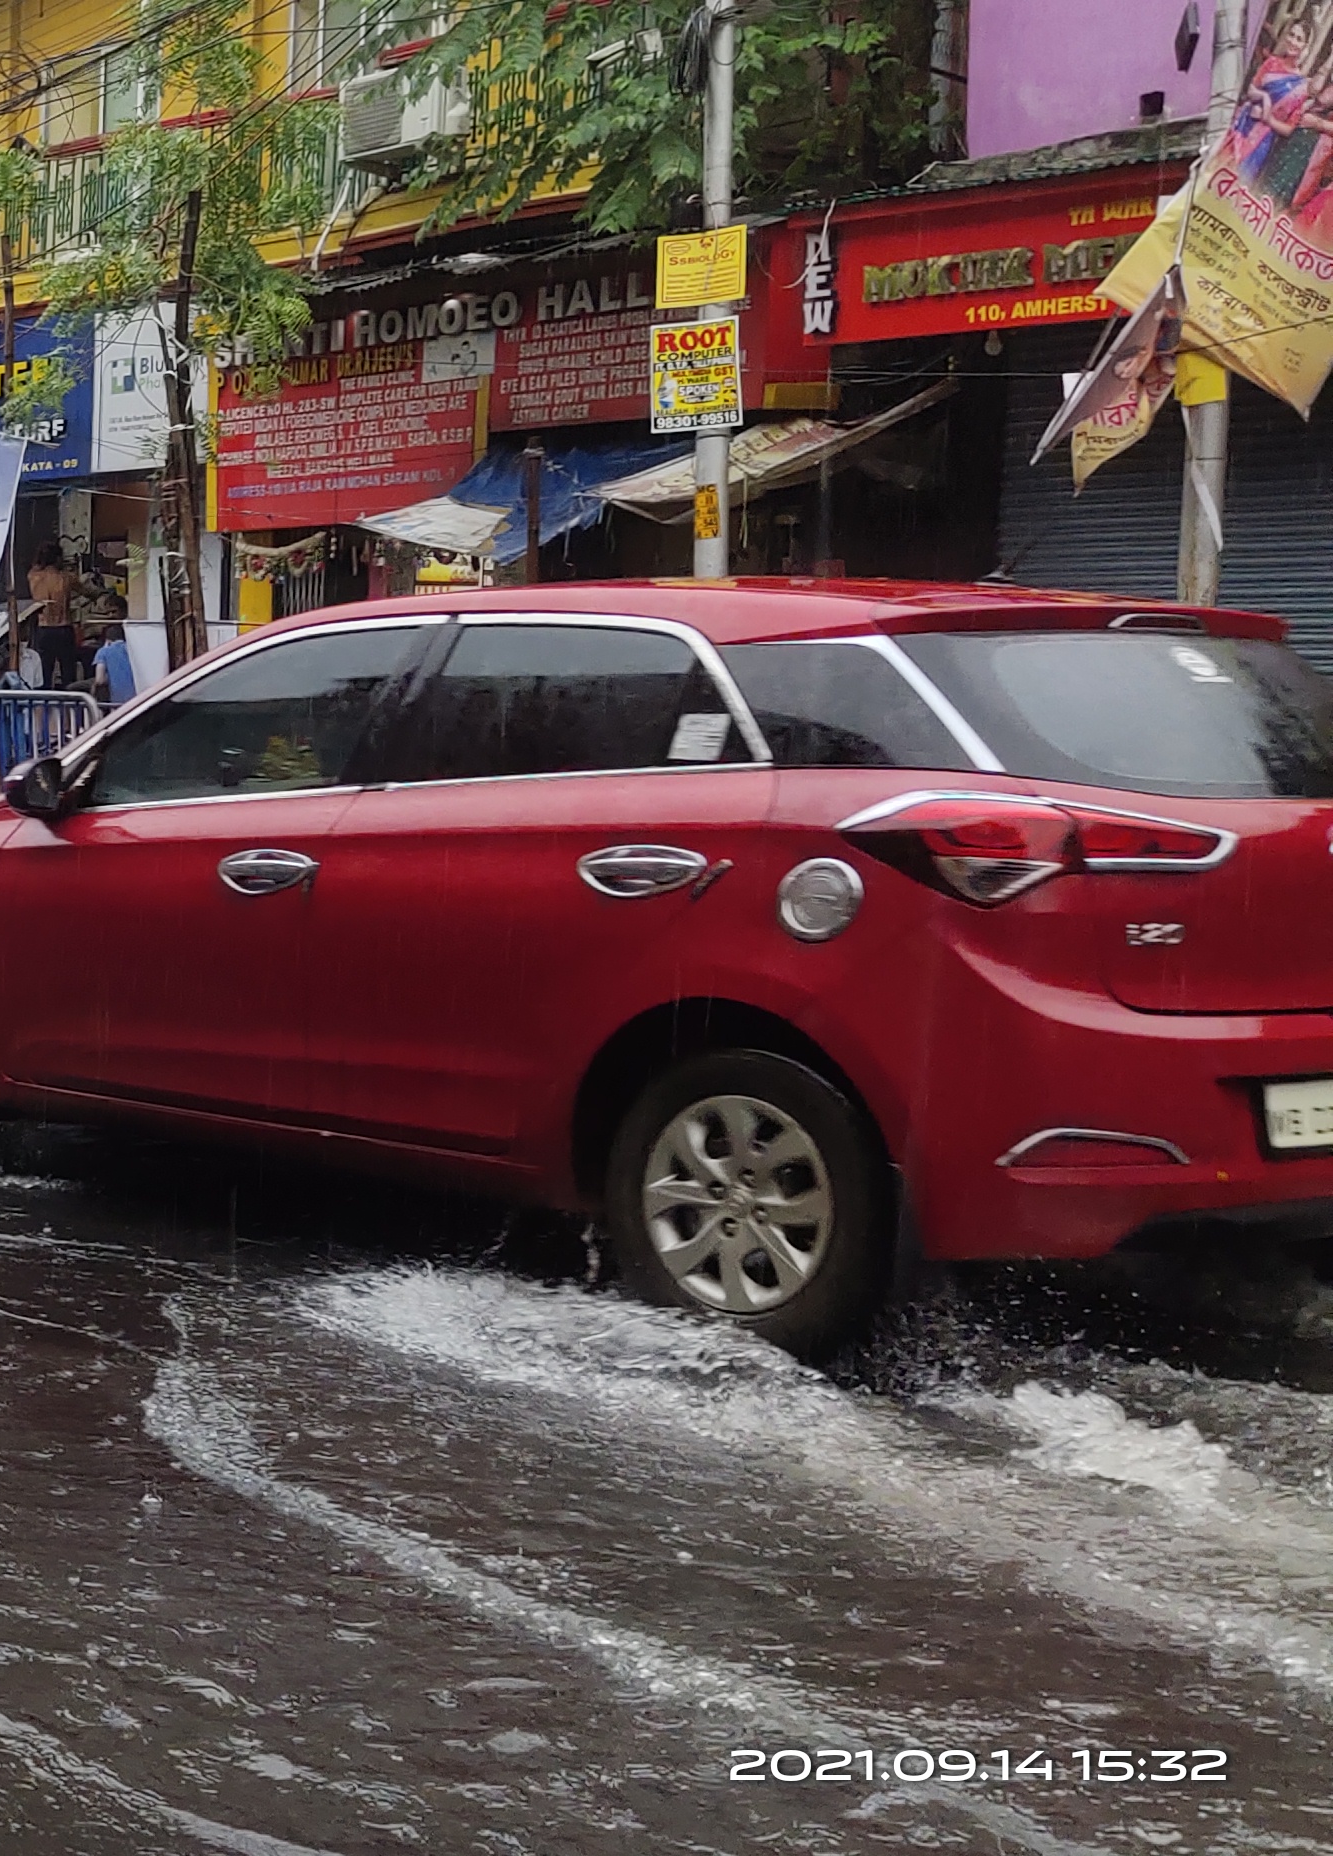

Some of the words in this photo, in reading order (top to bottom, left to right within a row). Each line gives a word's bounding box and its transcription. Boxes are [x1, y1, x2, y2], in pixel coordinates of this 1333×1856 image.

[353, 291, 519, 348] HOMOEO
[538, 271, 650, 321] HALL
[965, 304, 1006, 324] 110,
[1011, 297, 1109, 321] AMHERST
[519, 341, 550, 358] SUGAR
[552, 333, 601, 352] PARALYSIS
[657, 326, 731, 353] ROOT
[594, 348, 622, 365] CHILD
[657, 347, 731, 362] COMPUTER
[340, 378, 356, 391] THE
[500, 378, 518, 394] EYE
[529, 374, 548, 390] EAR
[550, 371, 576, 388] PILES
[678, 384, 720, 397] SPOKEN
[339, 391, 383, 408] COMPLETE
[384, 387, 408, 402] CARE
[409, 385, 426, 399] FOR
[428, 381, 451, 397] YOUR
[448, 394, 467, 411] ARE
[509, 391, 552, 409] STOMACH
[554, 388, 580, 404] GOUT
[583, 384, 606, 400] HAIR
[608, 381, 633, 399] LOSS
[512, 407, 549, 424] ASTHMA
[552, 403, 589, 420] CANCER
[656, 410, 738, 429] 98301-99516
